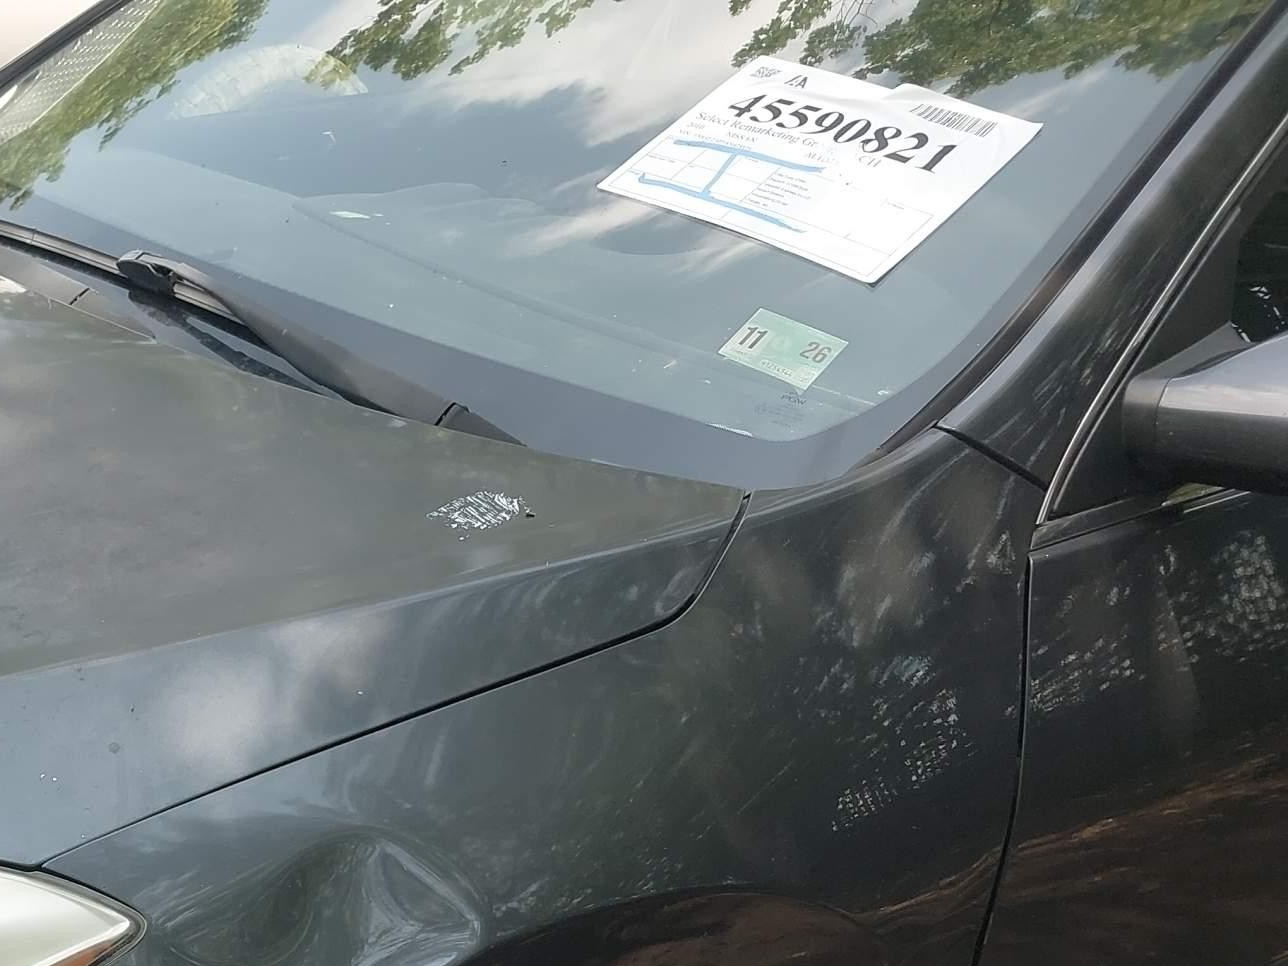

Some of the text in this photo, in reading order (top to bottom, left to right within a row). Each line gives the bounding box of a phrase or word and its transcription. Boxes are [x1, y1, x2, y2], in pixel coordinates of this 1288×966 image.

[695, 111, 730, 127] Select
[729, 118, 800, 144] Remarketing
[728, 93, 959, 174] 45590821
[738, 325, 833, 364] 11 26
